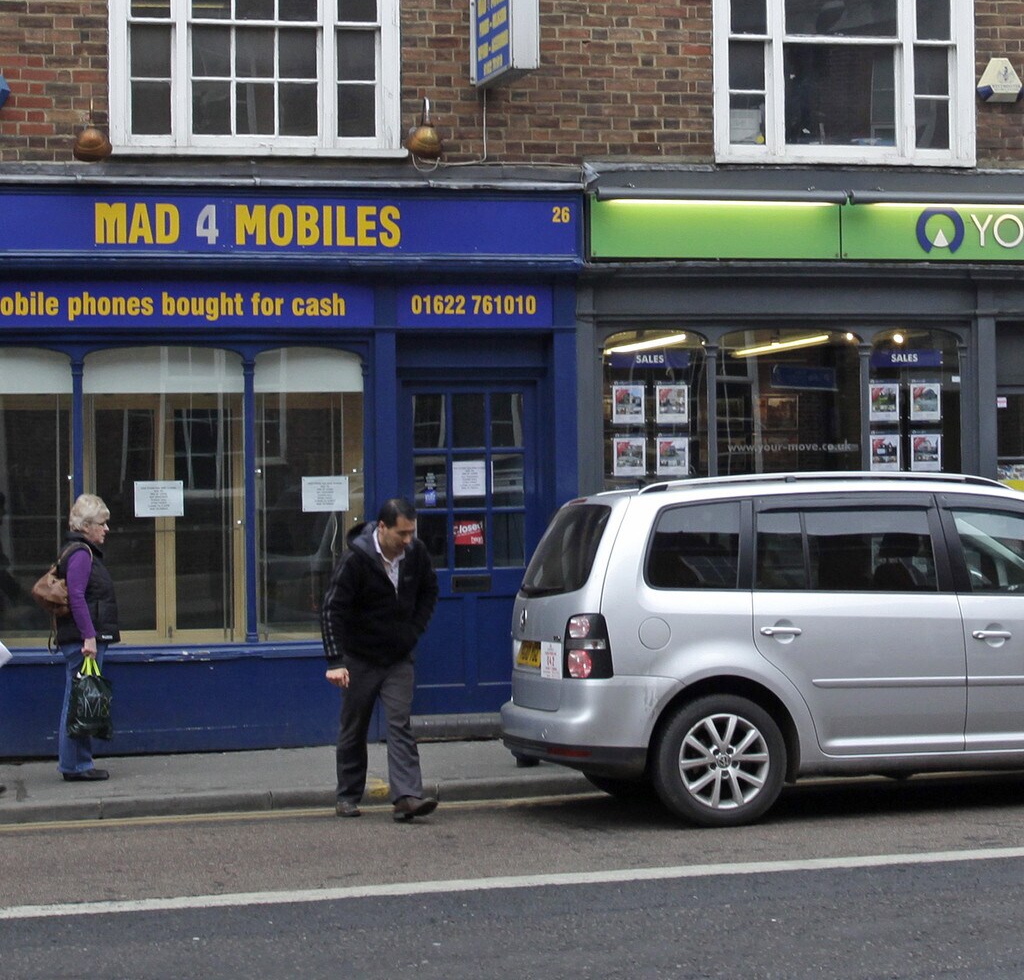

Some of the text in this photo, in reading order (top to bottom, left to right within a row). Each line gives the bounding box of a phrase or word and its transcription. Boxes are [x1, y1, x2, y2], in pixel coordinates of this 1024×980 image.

[552, 206, 571, 223] 26
[94, 202, 401, 248] MAD 4 MOBILES
[67, 291, 154, 321] phones
[162, 291, 243, 321] bought
[251, 292, 284, 316] for
[292, 292, 346, 316] cash
[411, 294, 537, 315] 01622 761010
[636, 354, 664, 364] SALES
[891, 353, 919, 363] SALES
[728, 438, 851, 454] www.your-move.co.uk
